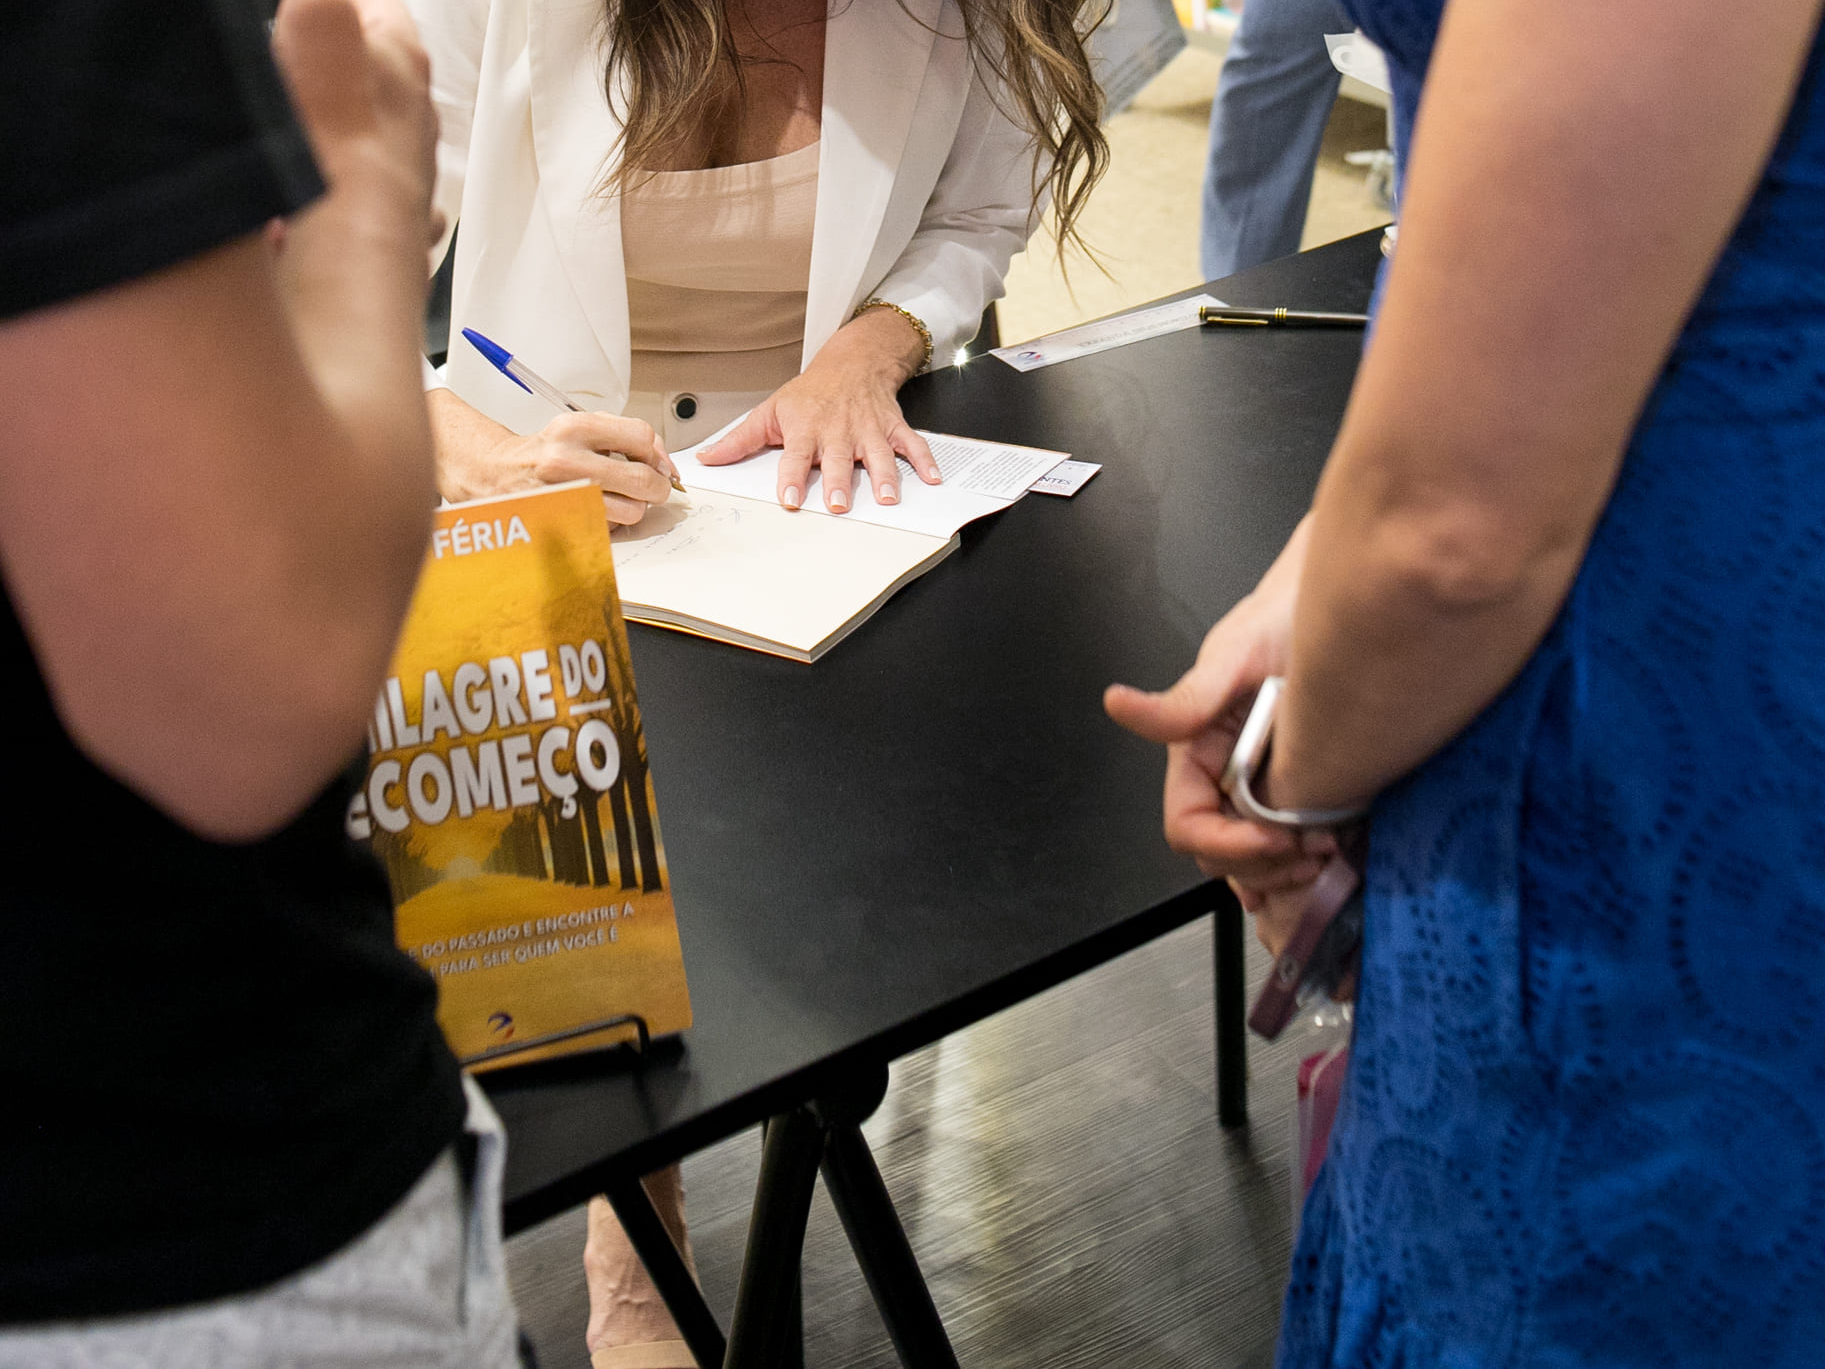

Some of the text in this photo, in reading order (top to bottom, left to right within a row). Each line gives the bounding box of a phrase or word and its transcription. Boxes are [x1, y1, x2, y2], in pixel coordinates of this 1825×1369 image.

[432, 516, 532, 560] FÉRIA
[558, 638, 607, 699] DO
[422, 941, 446, 960] DO
[448, 924, 520, 952] PASSADO
[523, 920, 532, 939] E
[535, 902, 619, 935] ENCONTRE
[623, 900, 635, 920] A
[439, 955, 479, 977] PARA
[482, 948, 511, 969] SER
[514, 937, 561, 966] QUEM
